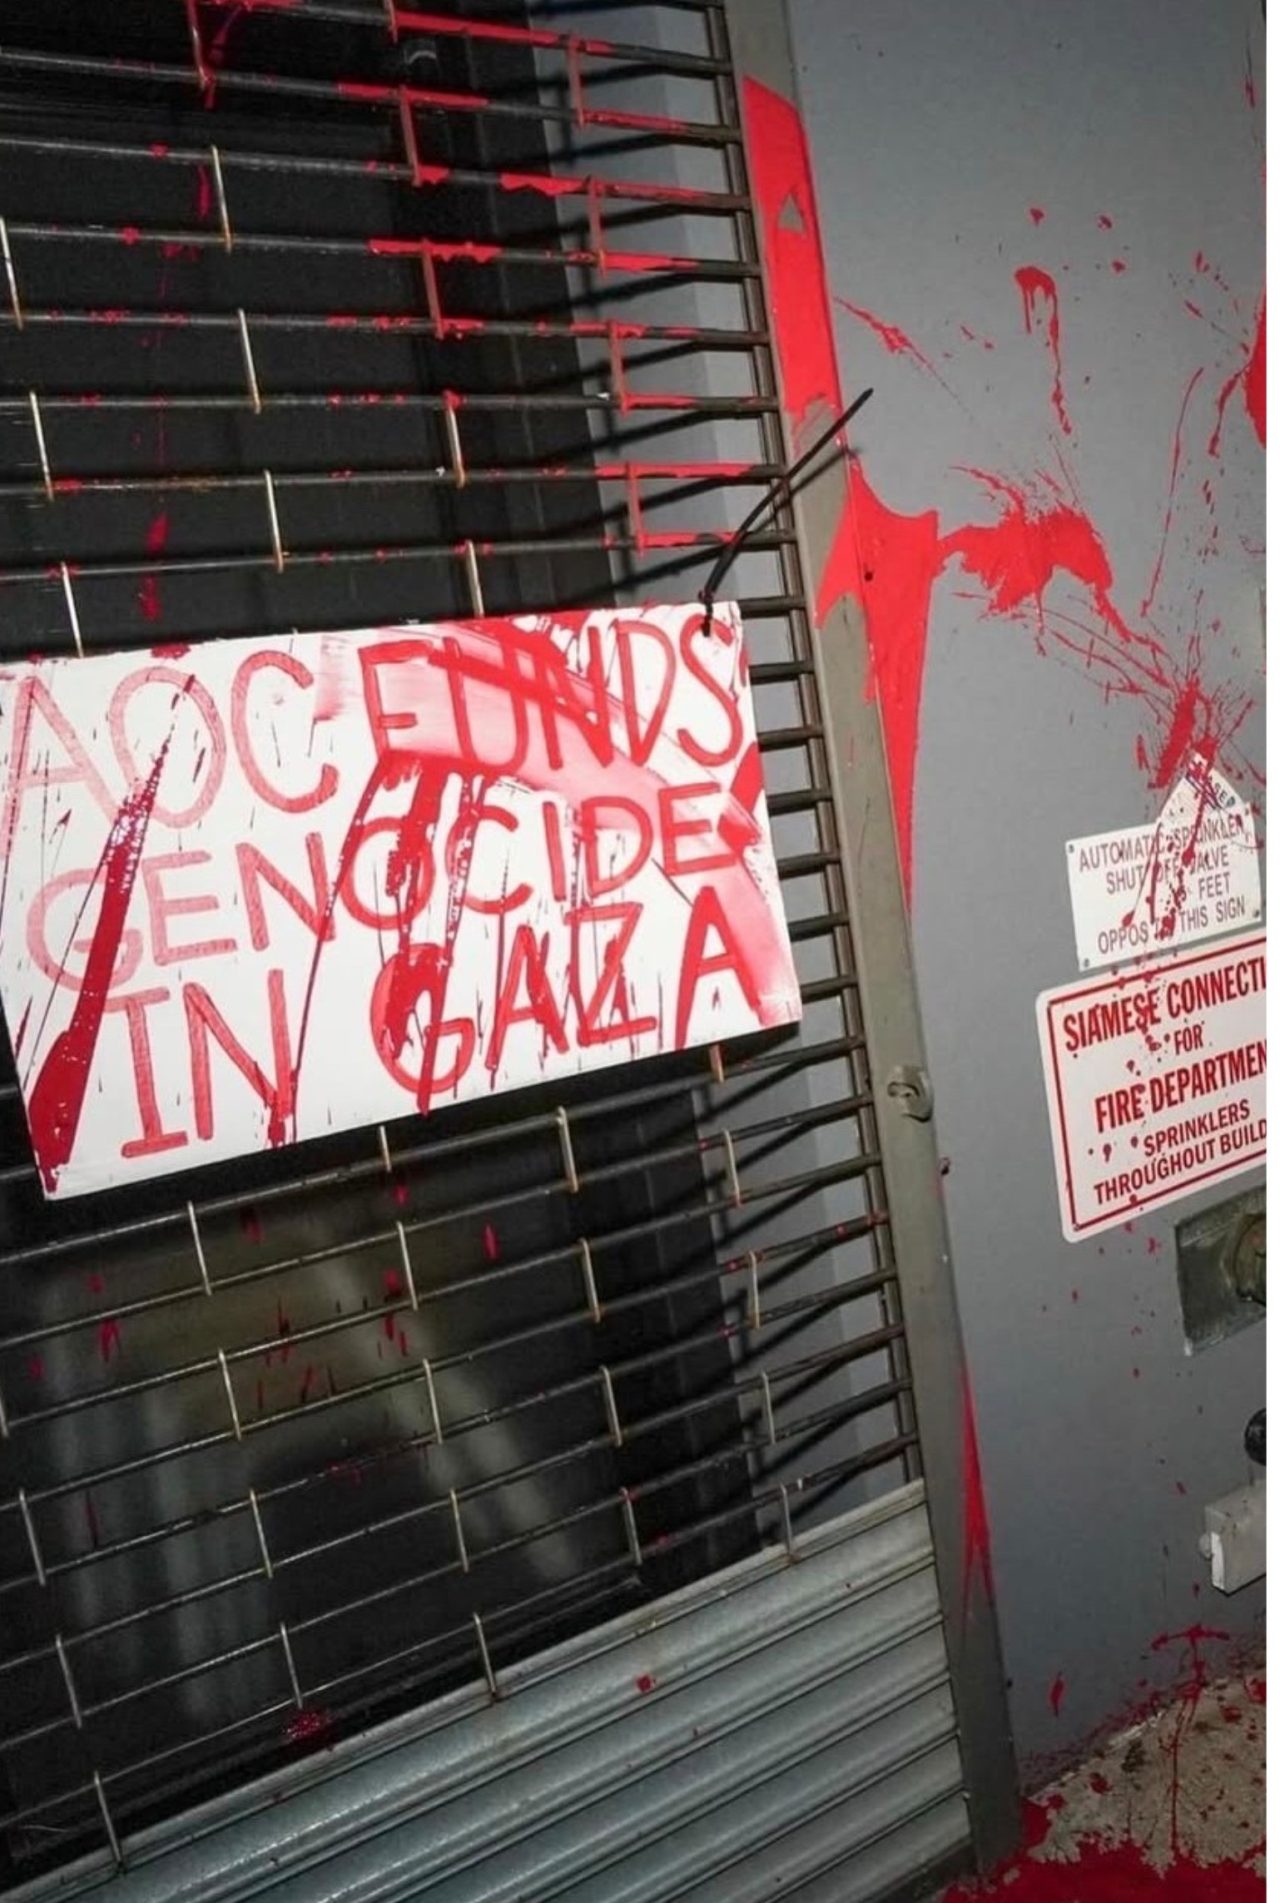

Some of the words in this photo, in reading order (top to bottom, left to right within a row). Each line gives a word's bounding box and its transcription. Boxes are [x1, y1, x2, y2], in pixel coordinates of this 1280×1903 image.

[2, 648, 338, 858] AOC
[358, 611, 745, 788] FUNDS
[27, 781, 738, 992] GENOCIDE
[1106, 864, 1145, 895] SHUT
[1198, 872, 1231, 900] FEET
[1179, 905, 1210, 933] THIS
[1216, 896, 1247, 923] SIGN
[102, 967, 294, 1160] IN
[370, 885, 764, 1118] GAZA
[1062, 986, 1162, 1052] SIAMESE
[1167, 956, 1266, 1020] CONNECTI
[1173, 1024, 1205, 1056] FOR
[1094, 1083, 1146, 1134] FIRE
[1143, 1098, 1251, 1158] SPRINKLERS
[1093, 1139, 1217, 1206] THROUGHOUT
